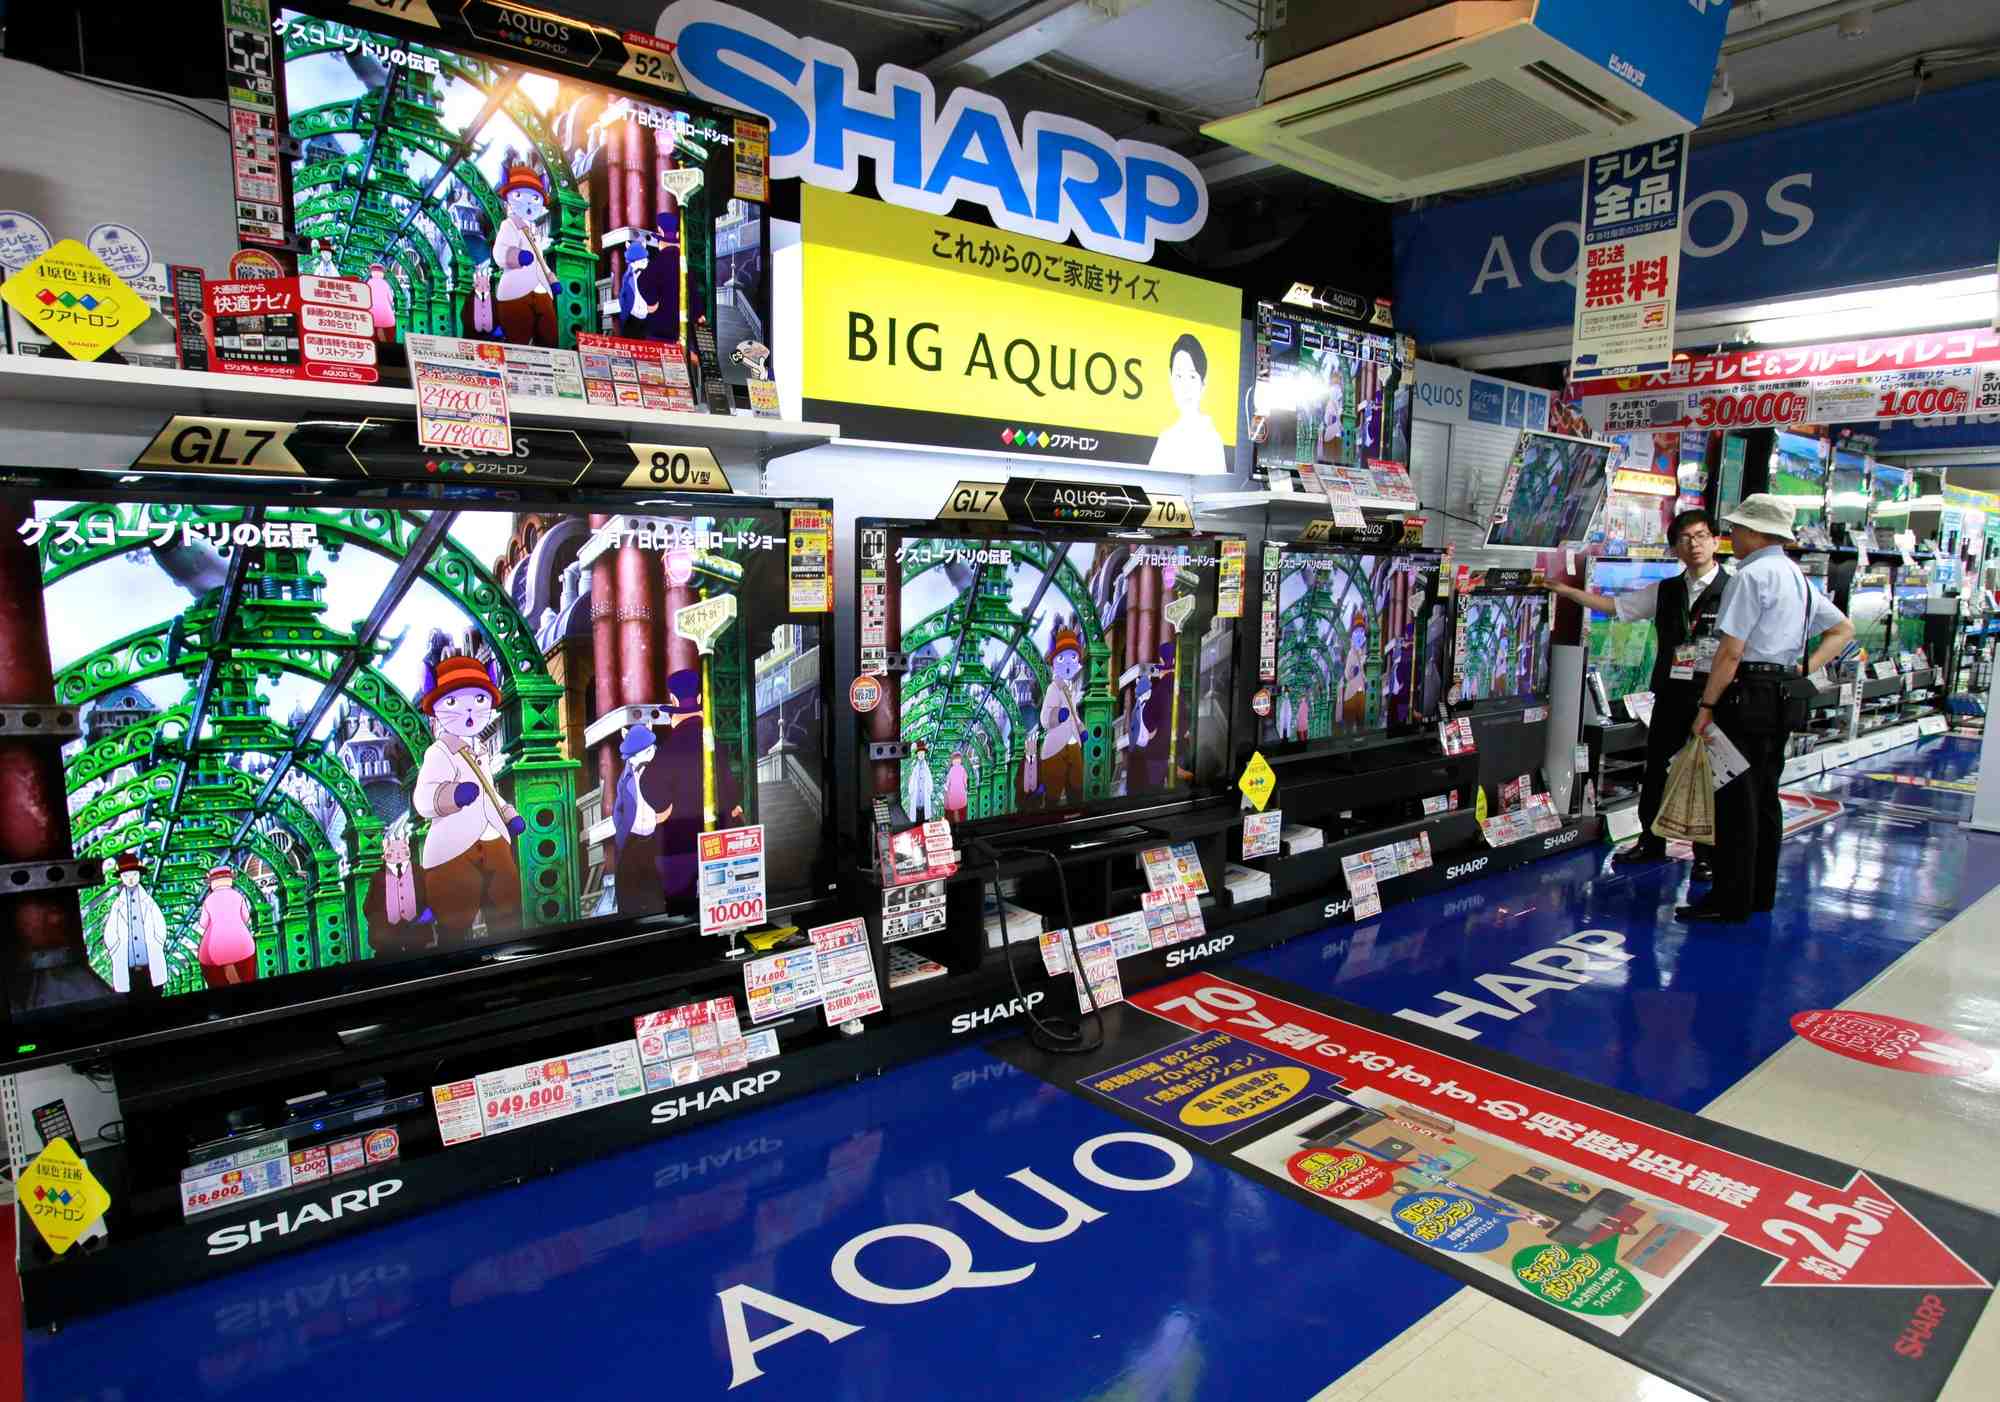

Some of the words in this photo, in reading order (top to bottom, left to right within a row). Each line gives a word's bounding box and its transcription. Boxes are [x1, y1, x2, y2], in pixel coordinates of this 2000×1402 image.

[498, 9, 570, 42] AQUOS
[228, 29, 271, 78] 52
[272, 17, 440, 75] グスコーブドリの伝記
[533, 37, 569, 56] クアトロン
[675, 20, 1200, 246] SHARP
[1593, 138, 1680, 182] テレビ
[1592, 173, 1674, 228] 全品
[1469, 171, 1815, 297] AQOS
[930, 228, 1161, 305] これからのご家庭サイズ
[1586, 243, 1625, 268] 配送
[212, 282, 267, 296] 大画面だから
[1585, 255, 1669, 308] 無料
[39, 308, 120, 328] クアトロン
[213, 293, 292, 314] 快適ナビ!
[317, 317, 358, 332] お知らせ!
[847, 310, 944, 373] BIG
[964, 331, 1145, 400] AQUOS
[1412, 382, 1464, 408] AQUOS
[169, 427, 276, 466] GL7
[1050, 432, 1099, 452] クアトロン
[476, 463, 528, 475] クアトロン
[649, 451, 712, 486] 80V型
[953, 489, 998, 513] GL7
[1053, 488, 1108, 507] AQUOS
[1079, 509, 1107, 521] クアトロン
[15, 515, 321, 551] グスコーブドリの伝記
[894, 545, 1013, 566] グスコーブドリの伝記
[1543, 830, 1579, 850] SHARP
[1446, 856, 1489, 880] SHARP
[708, 898, 764, 924] 10,000
[1165, 933, 1236, 969] SHARP
[951, 990, 1046, 1035] SHARP
[650, 1070, 782, 1125] SHARP
[33, 1203, 85, 1223] クアトロン
[207, 1178, 404, 1256] SHARP
[1894, 1294, 1945, 1358] SHARP
